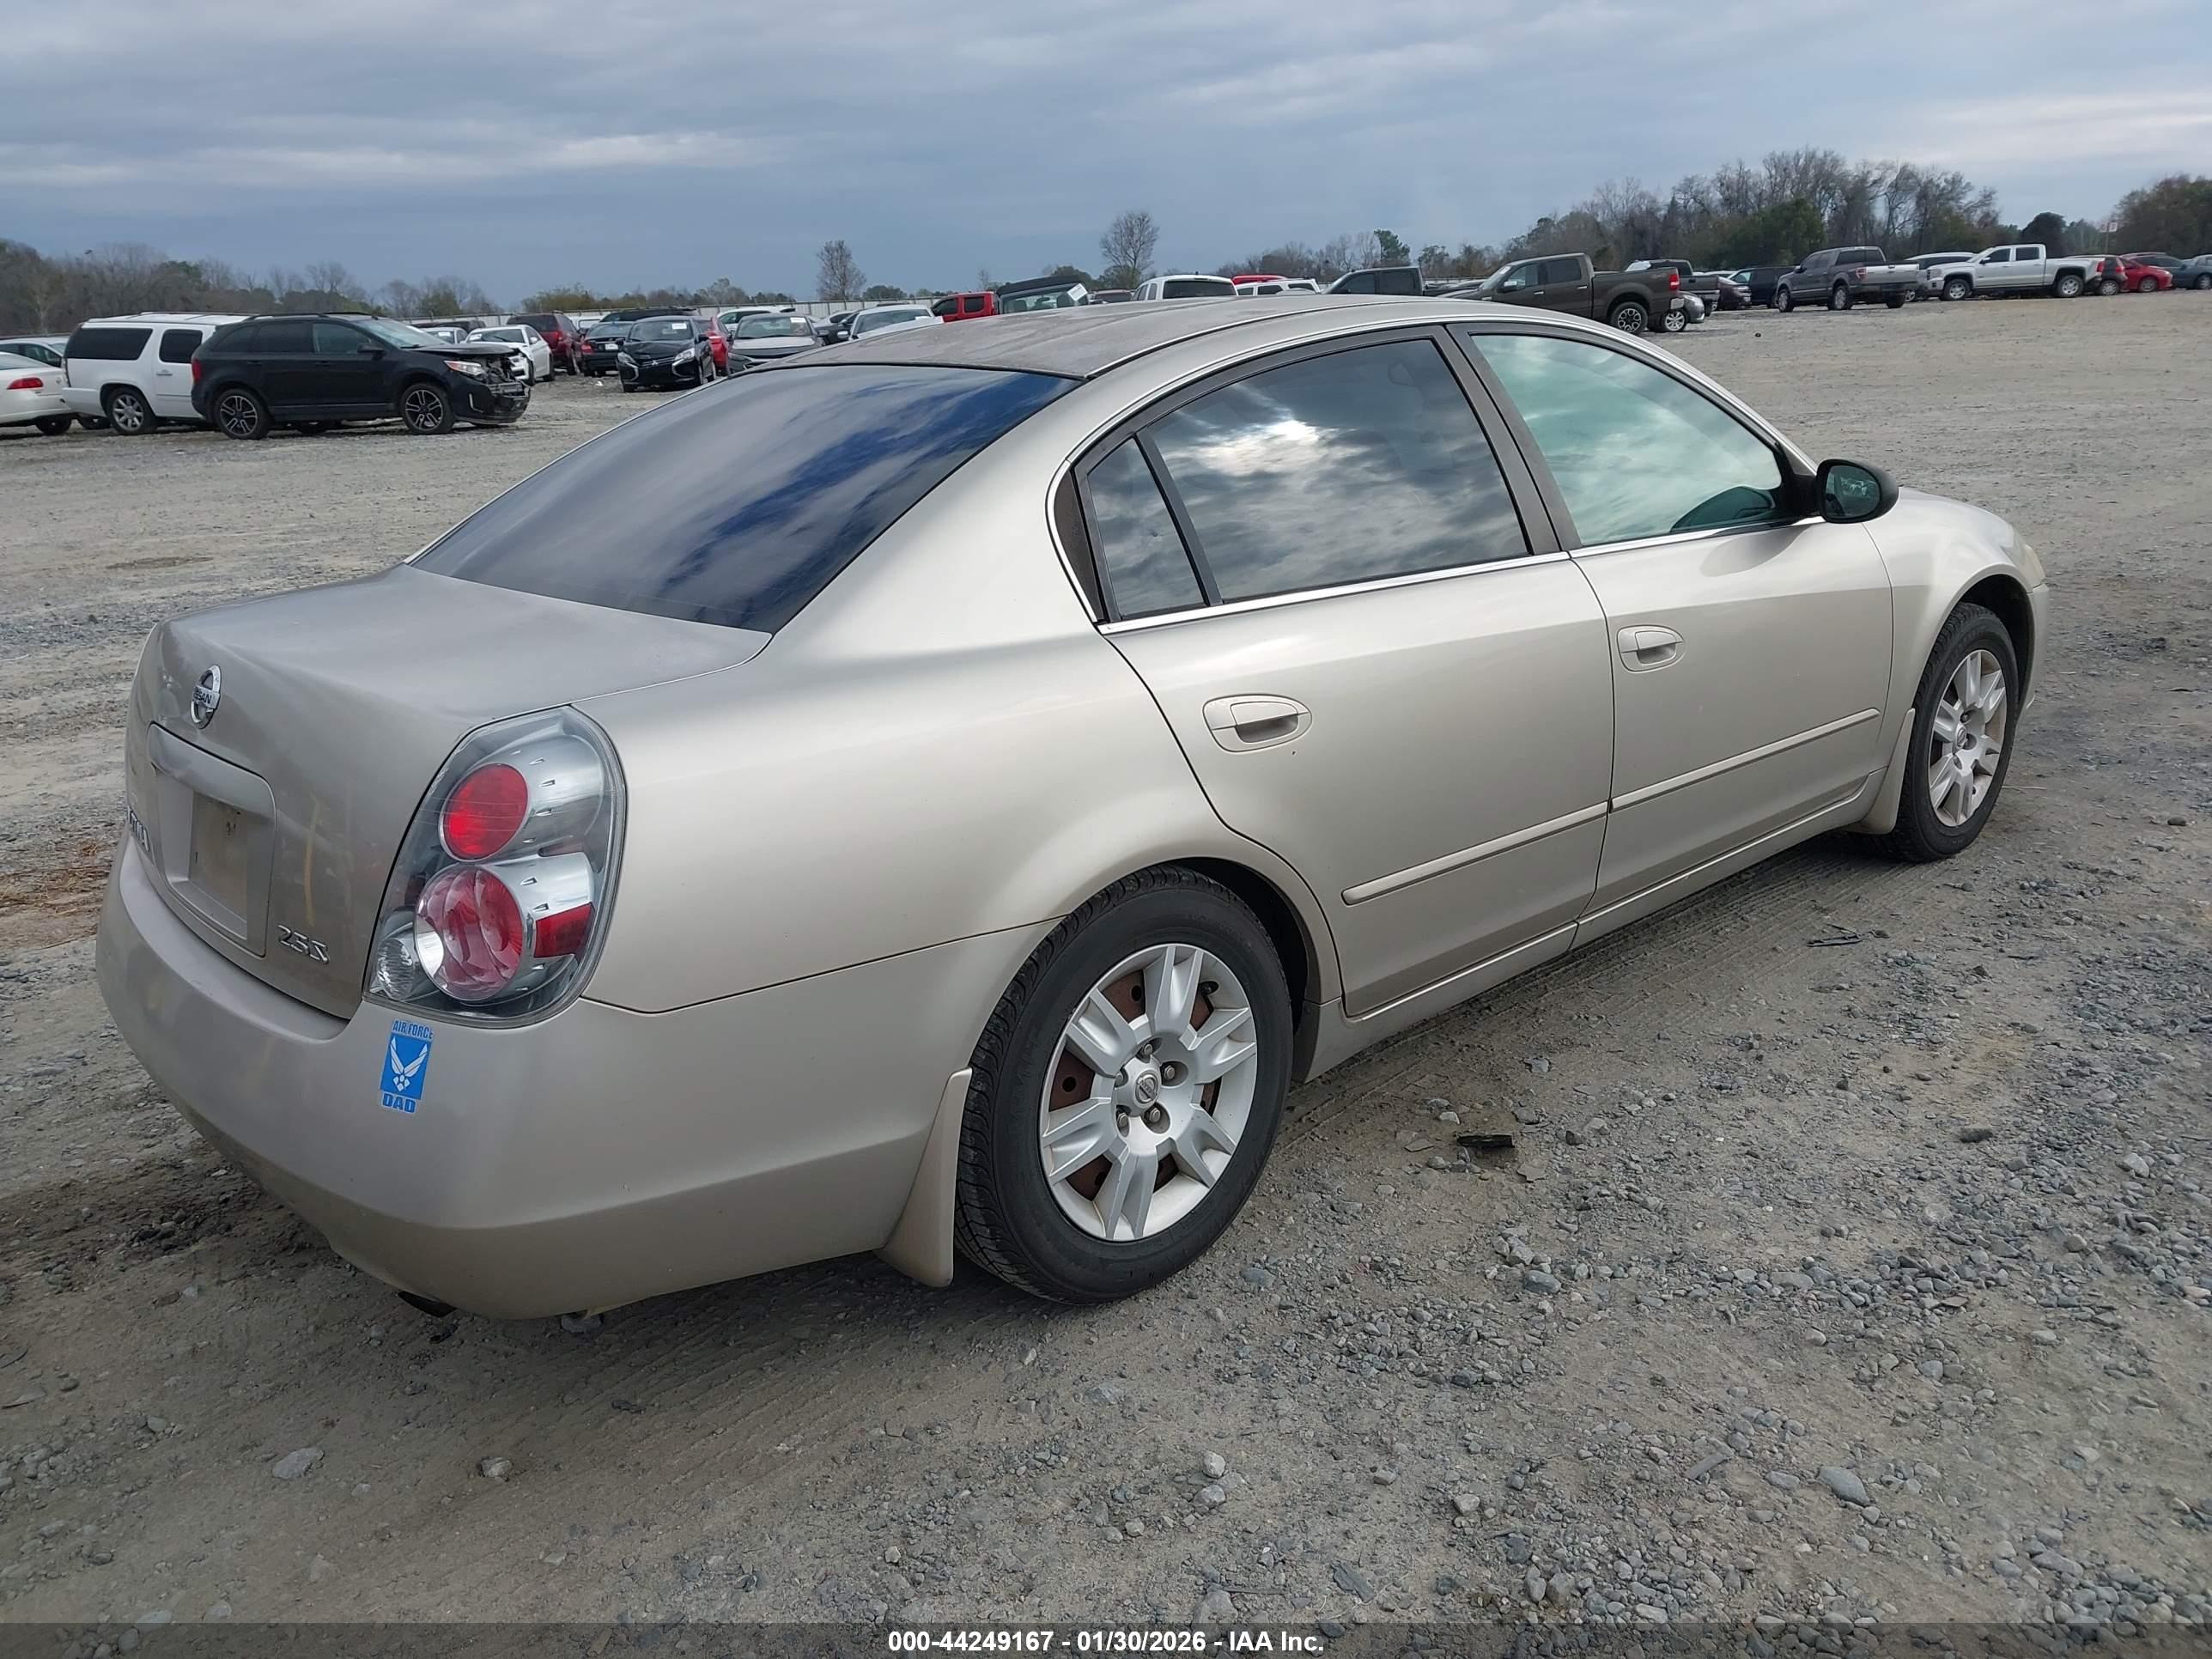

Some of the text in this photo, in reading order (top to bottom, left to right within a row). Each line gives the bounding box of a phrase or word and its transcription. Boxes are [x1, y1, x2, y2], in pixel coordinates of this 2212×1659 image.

[392, 1020, 434, 1039] AIR FORCE
[382, 1092, 416, 1114] DAD
